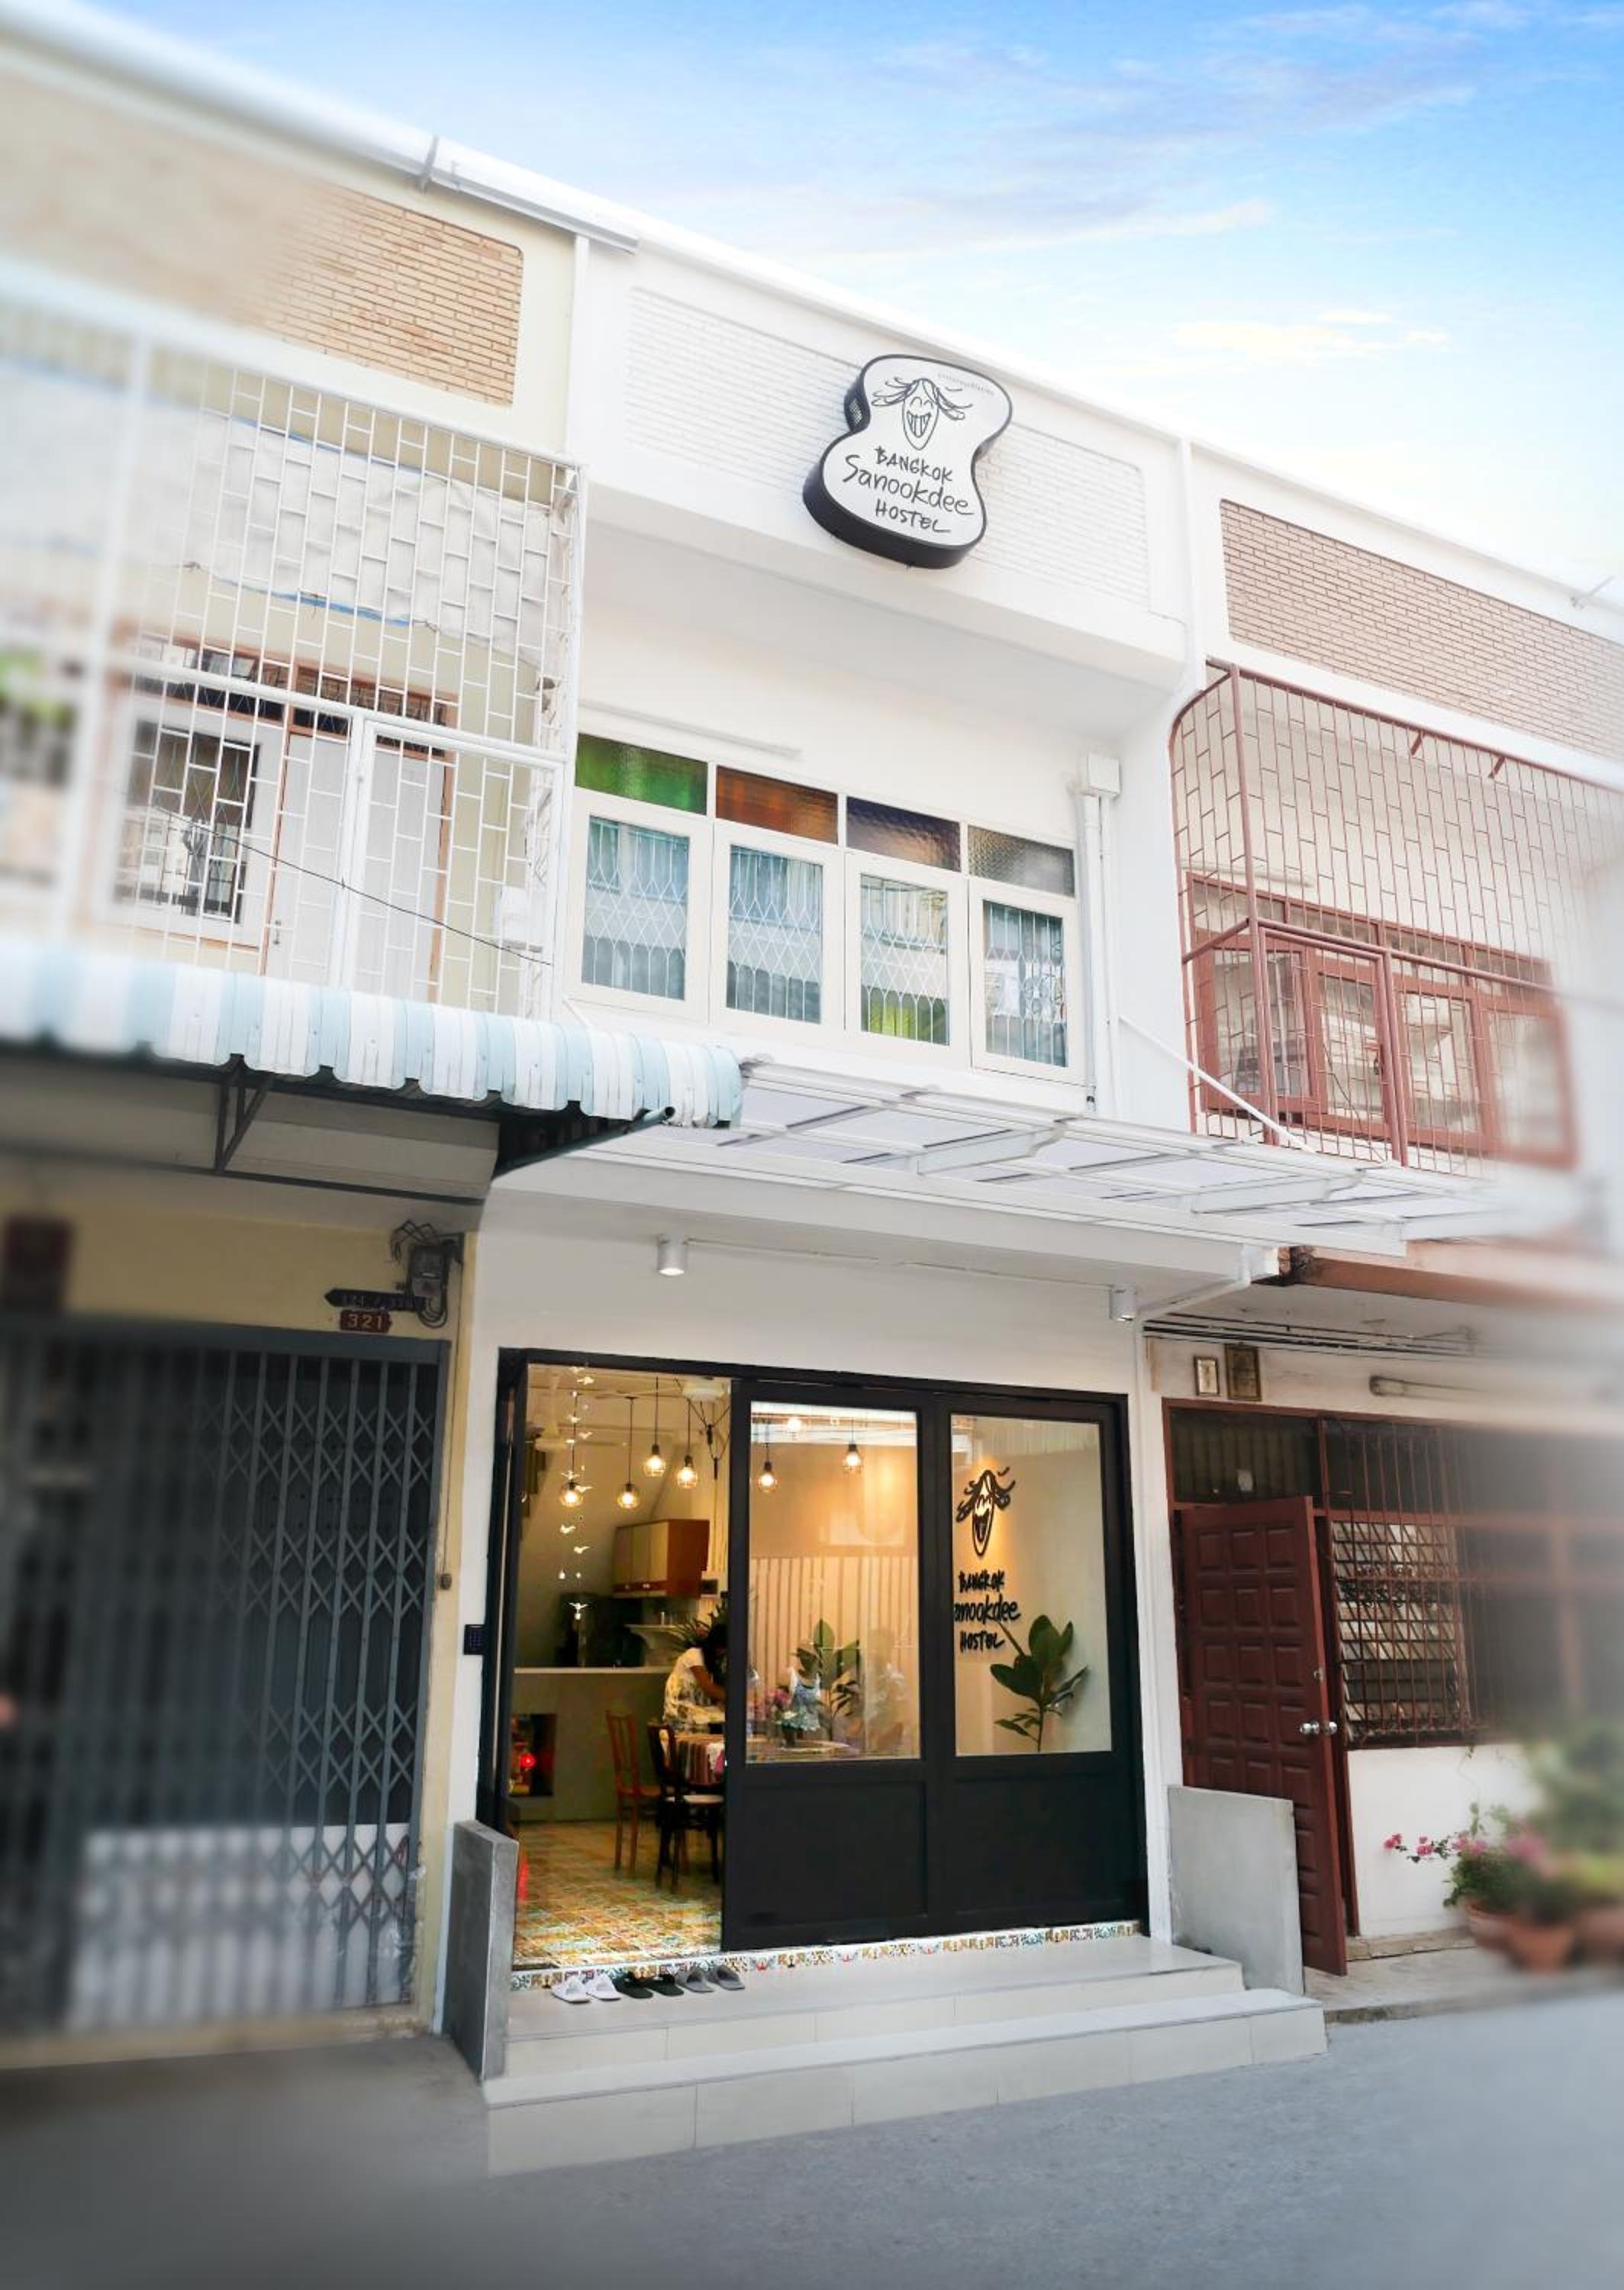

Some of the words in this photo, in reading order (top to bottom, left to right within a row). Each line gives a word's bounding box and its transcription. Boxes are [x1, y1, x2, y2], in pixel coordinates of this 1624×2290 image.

[874, 446, 953, 482] BANGKOK
[843, 454, 975, 515] Sanookdee
[875, 498, 952, 533] HOSTEL
[348, 1314, 382, 1330] 321
[953, 1593, 1021, 1624] anookdee
[960, 1630, 1005, 1653] HOSTEL
